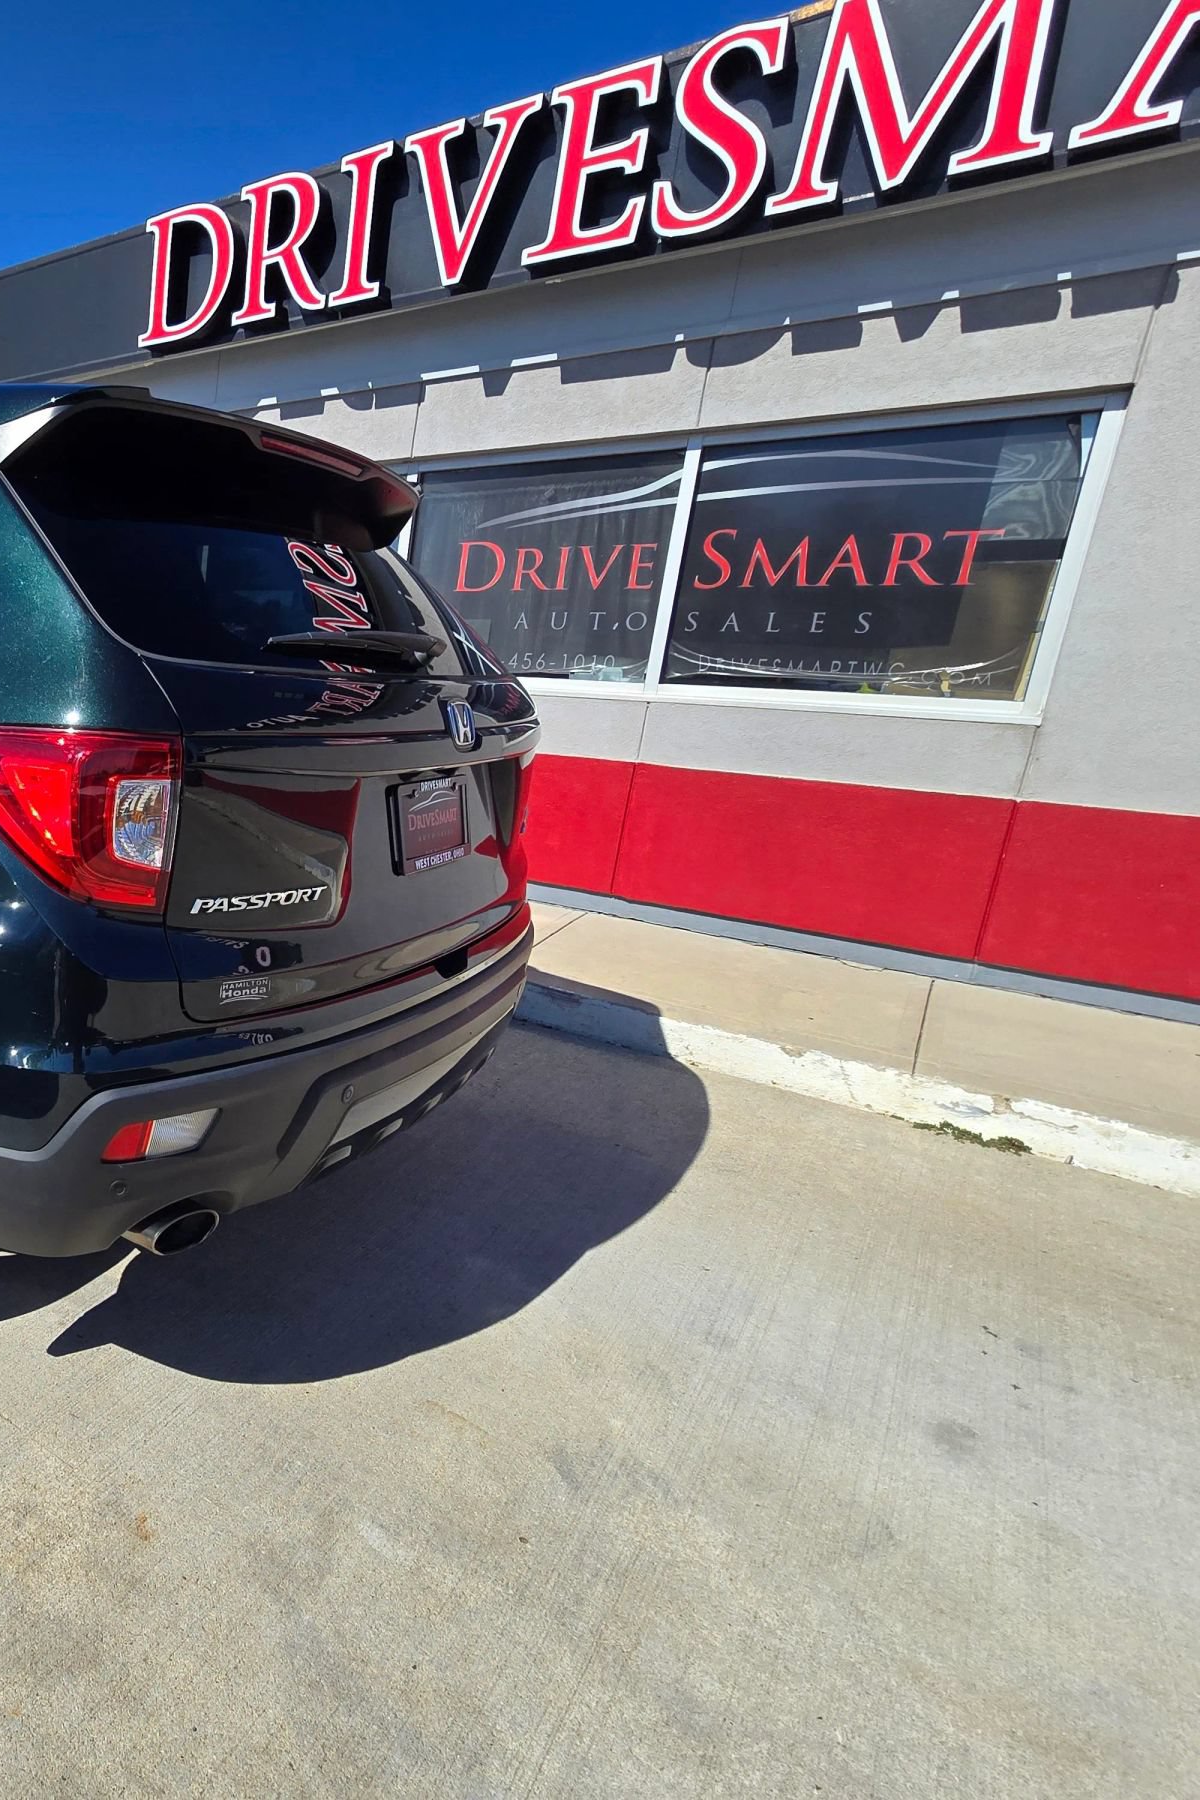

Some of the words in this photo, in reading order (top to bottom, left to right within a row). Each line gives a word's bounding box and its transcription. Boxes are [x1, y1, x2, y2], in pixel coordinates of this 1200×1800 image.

[453, 540, 658, 592] DRIVE
[693, 528, 1006, 590] SMART
[514, 611, 648, 631] AUTO
[684, 611, 872, 634] SALES
[415, 857, 430, 870] WEST
[453, 847, 465, 858] OHIO
[190, 885, 328, 914] PASSPORT
[221, 986, 267, 999] Honda
[222, 979, 269, 991] HAMILTON
